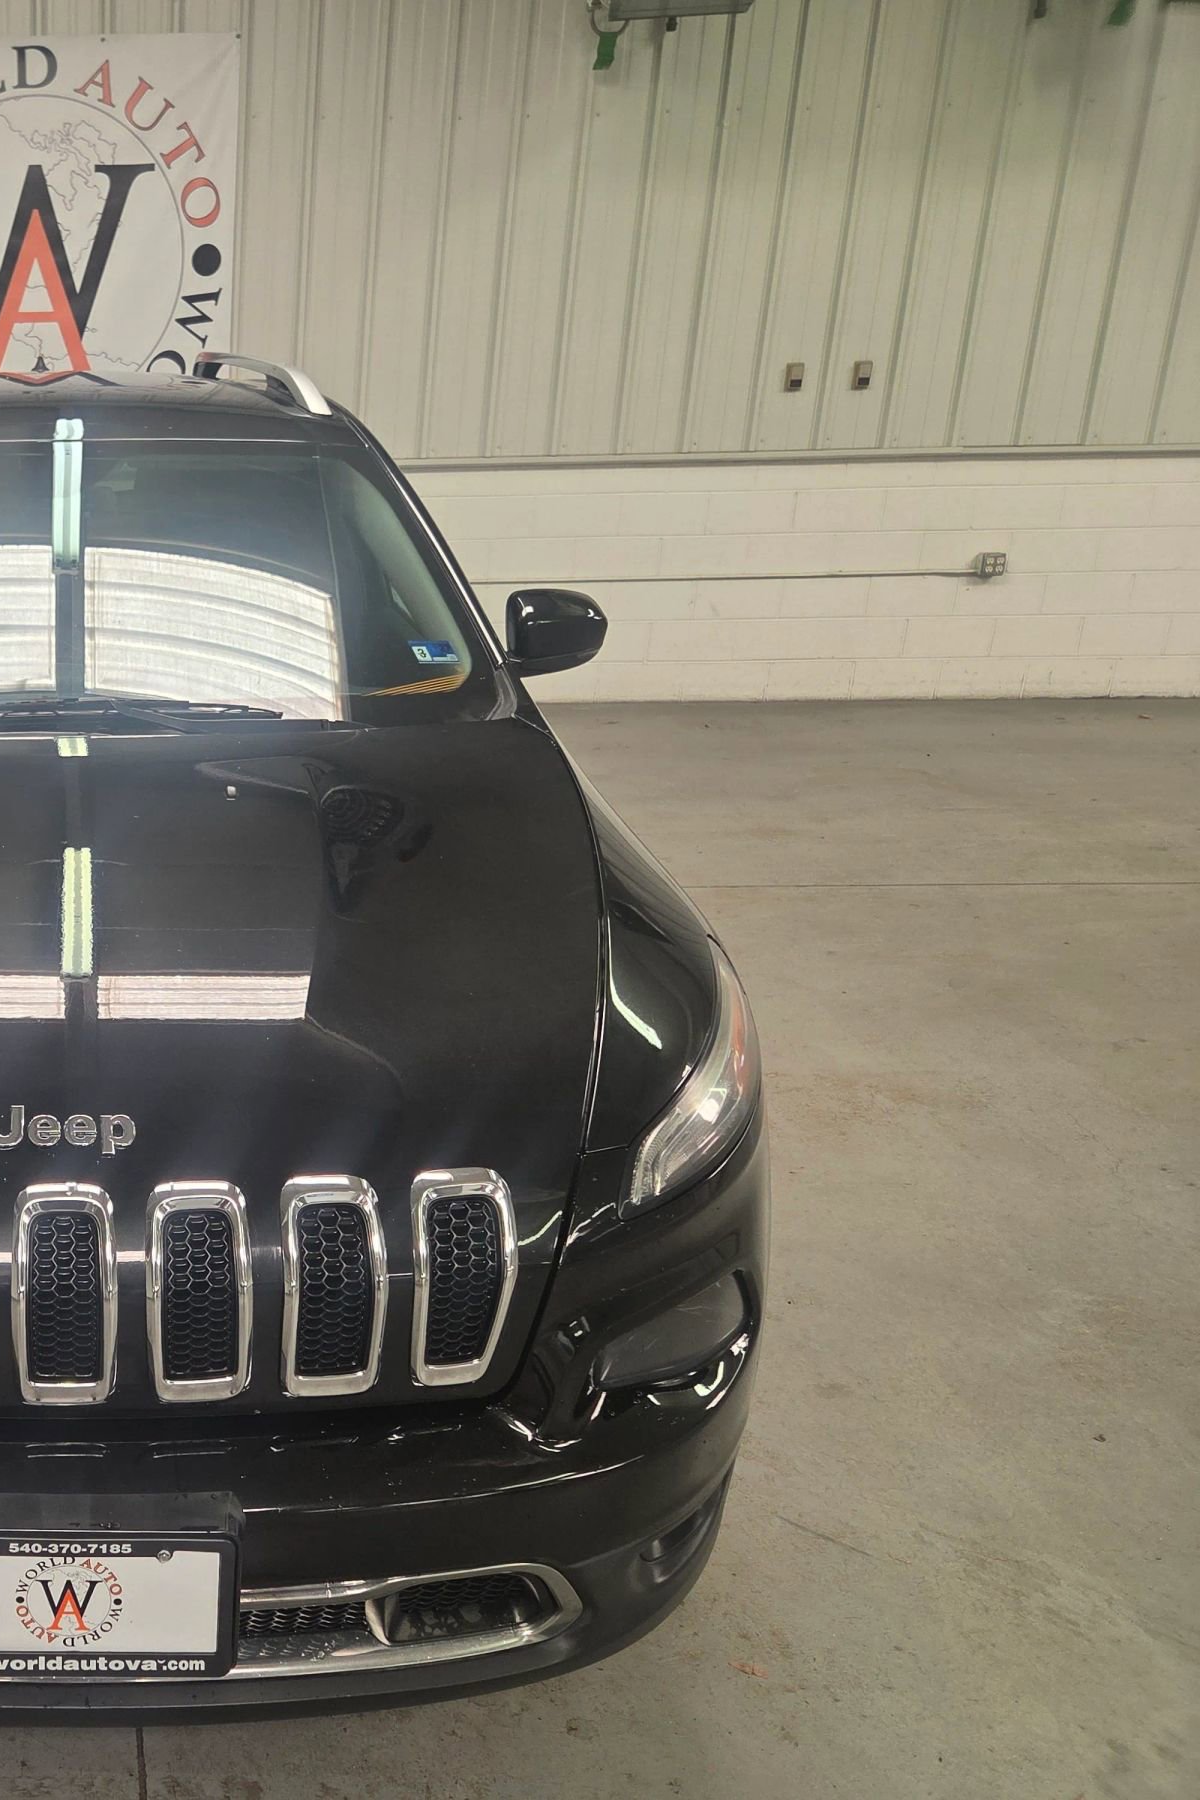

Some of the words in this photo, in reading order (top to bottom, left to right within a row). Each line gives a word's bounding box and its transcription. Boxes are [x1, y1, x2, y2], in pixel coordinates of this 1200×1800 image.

[73, 59, 221, 228] AUTO
[8, 1542, 133, 1554] 540-370-7185
[15, 1556, 76, 1593] WORLD
[79, 1558, 123, 1596] AUTO
[15, 1604, 59, 1644] AUTO
[62, 1607, 123, 1647] WORLD
